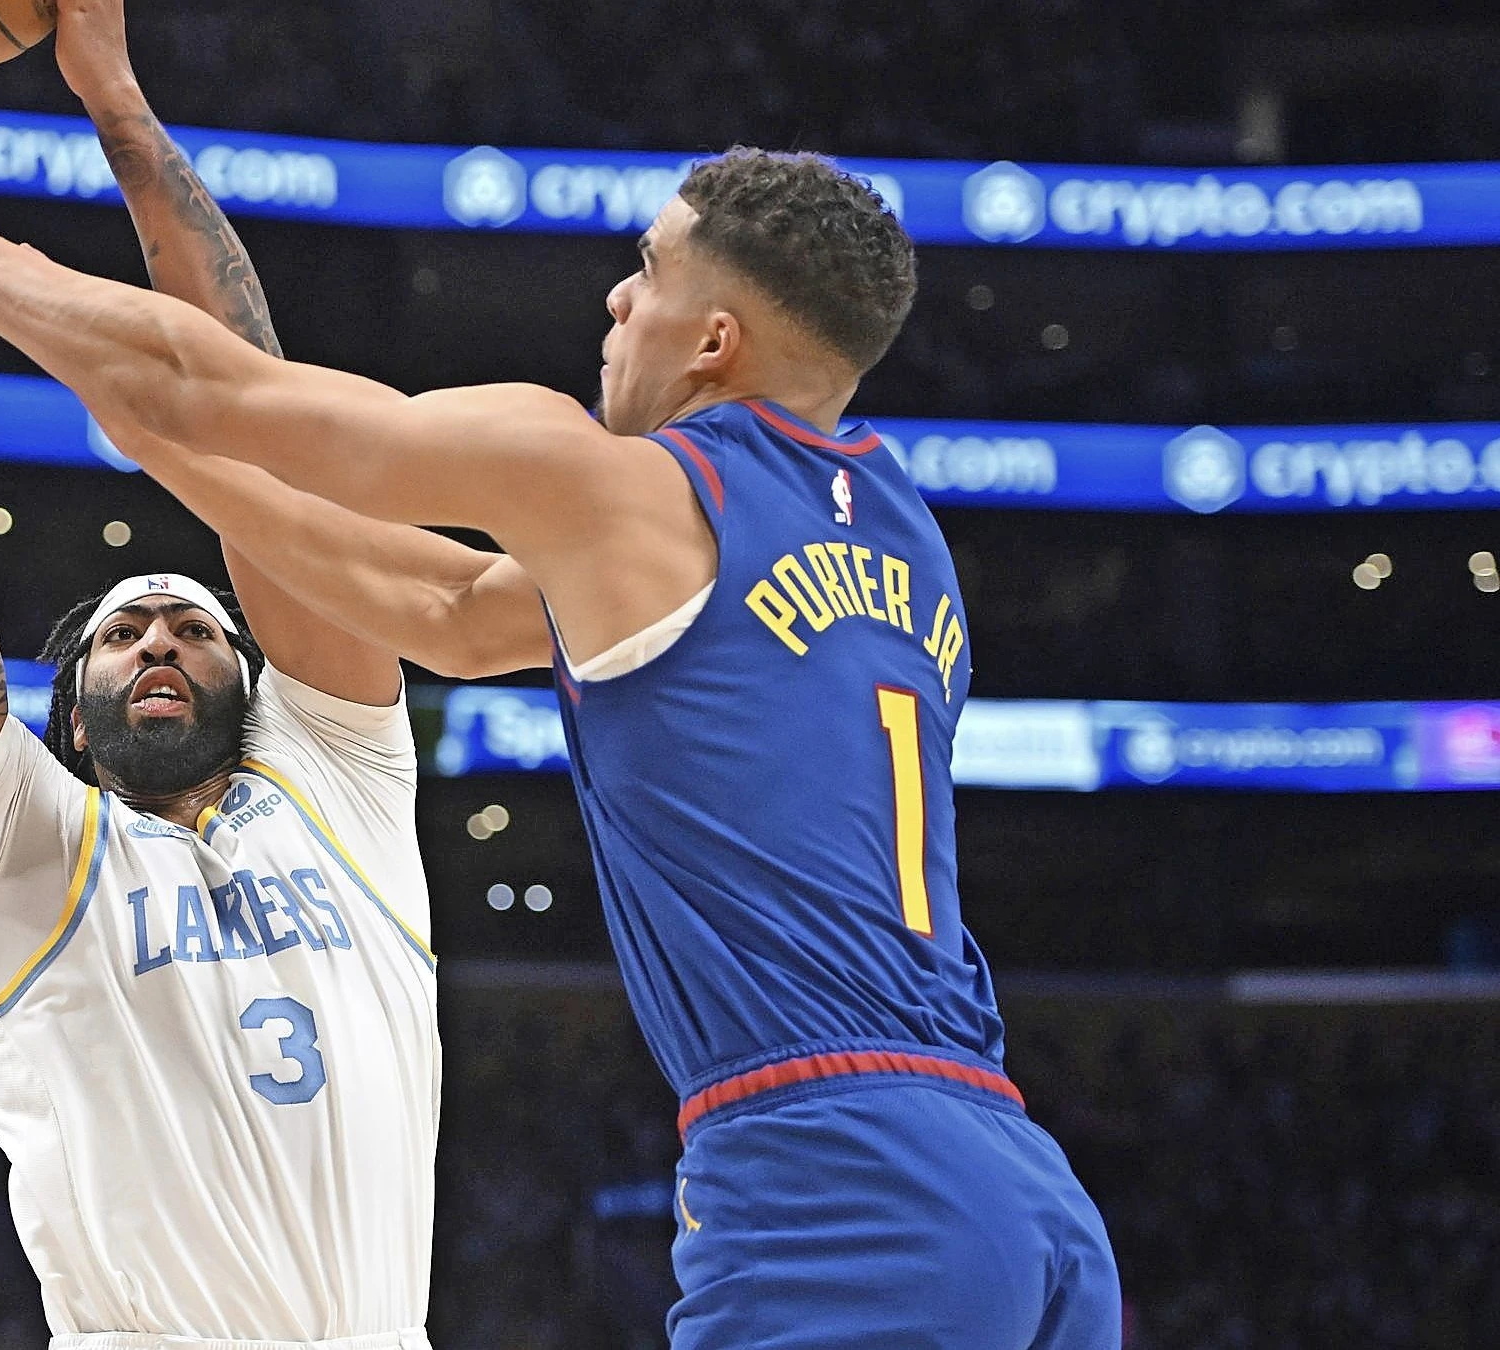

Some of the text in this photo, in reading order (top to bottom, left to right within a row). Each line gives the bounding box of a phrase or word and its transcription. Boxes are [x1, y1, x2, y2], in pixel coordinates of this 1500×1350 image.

[1050, 173, 1424, 246] crypto.com
[744, 542, 914, 656] PORTER
[874, 681, 934, 939] 1
[239, 996, 327, 1105] 3
